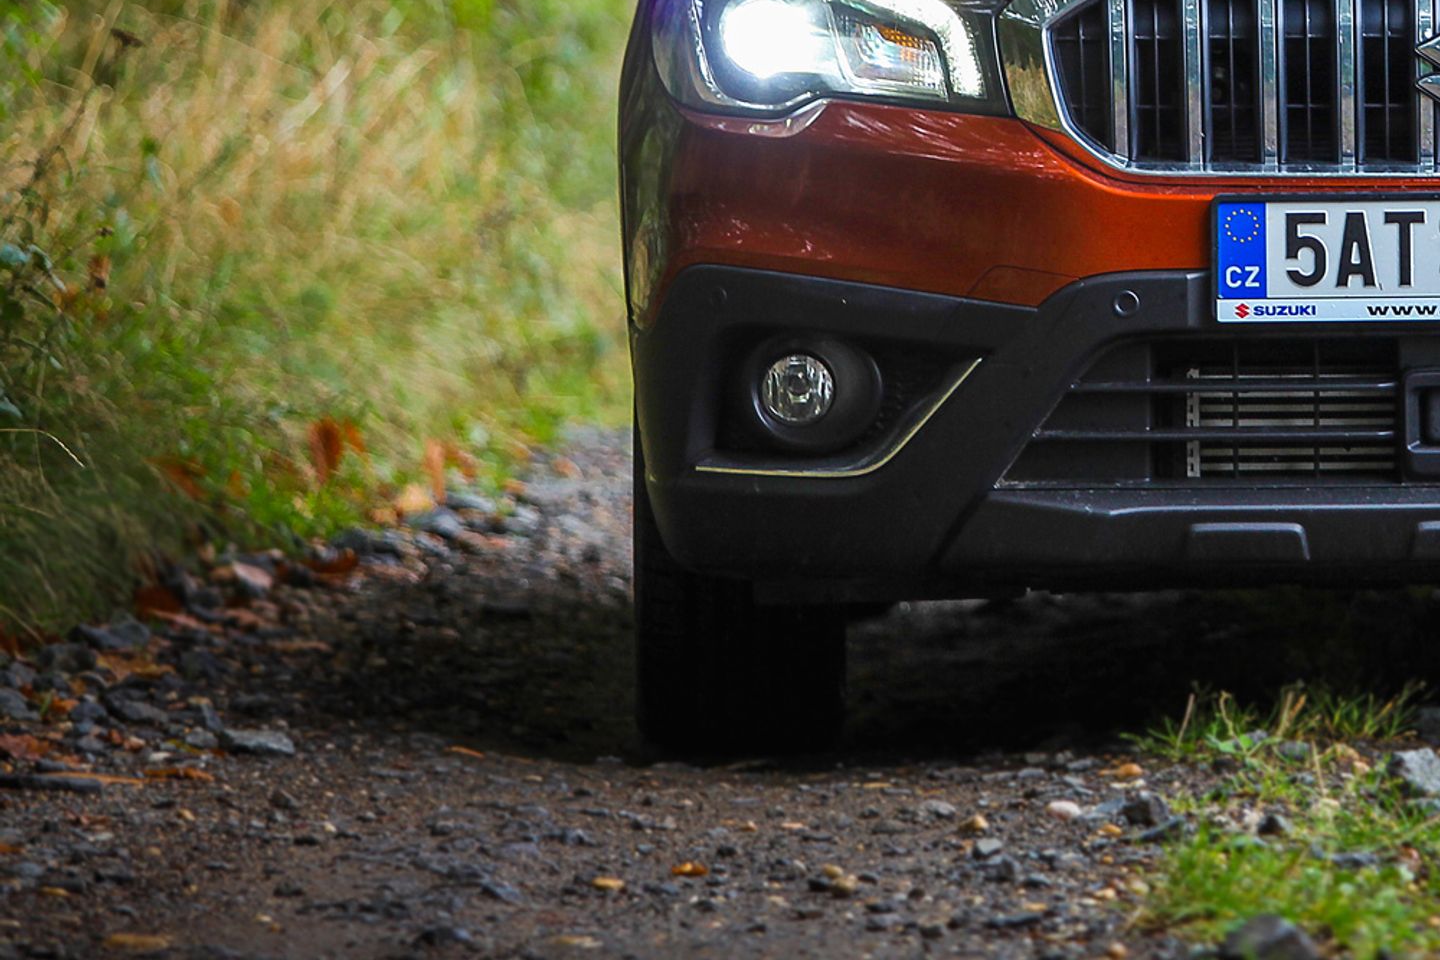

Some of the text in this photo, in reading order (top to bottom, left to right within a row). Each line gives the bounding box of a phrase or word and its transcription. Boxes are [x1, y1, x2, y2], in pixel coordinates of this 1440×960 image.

[1285, 209, 1426, 289] 5AT
[1225, 266, 1260, 289] CZ
[1253, 304, 1316, 317] SUZUKI
